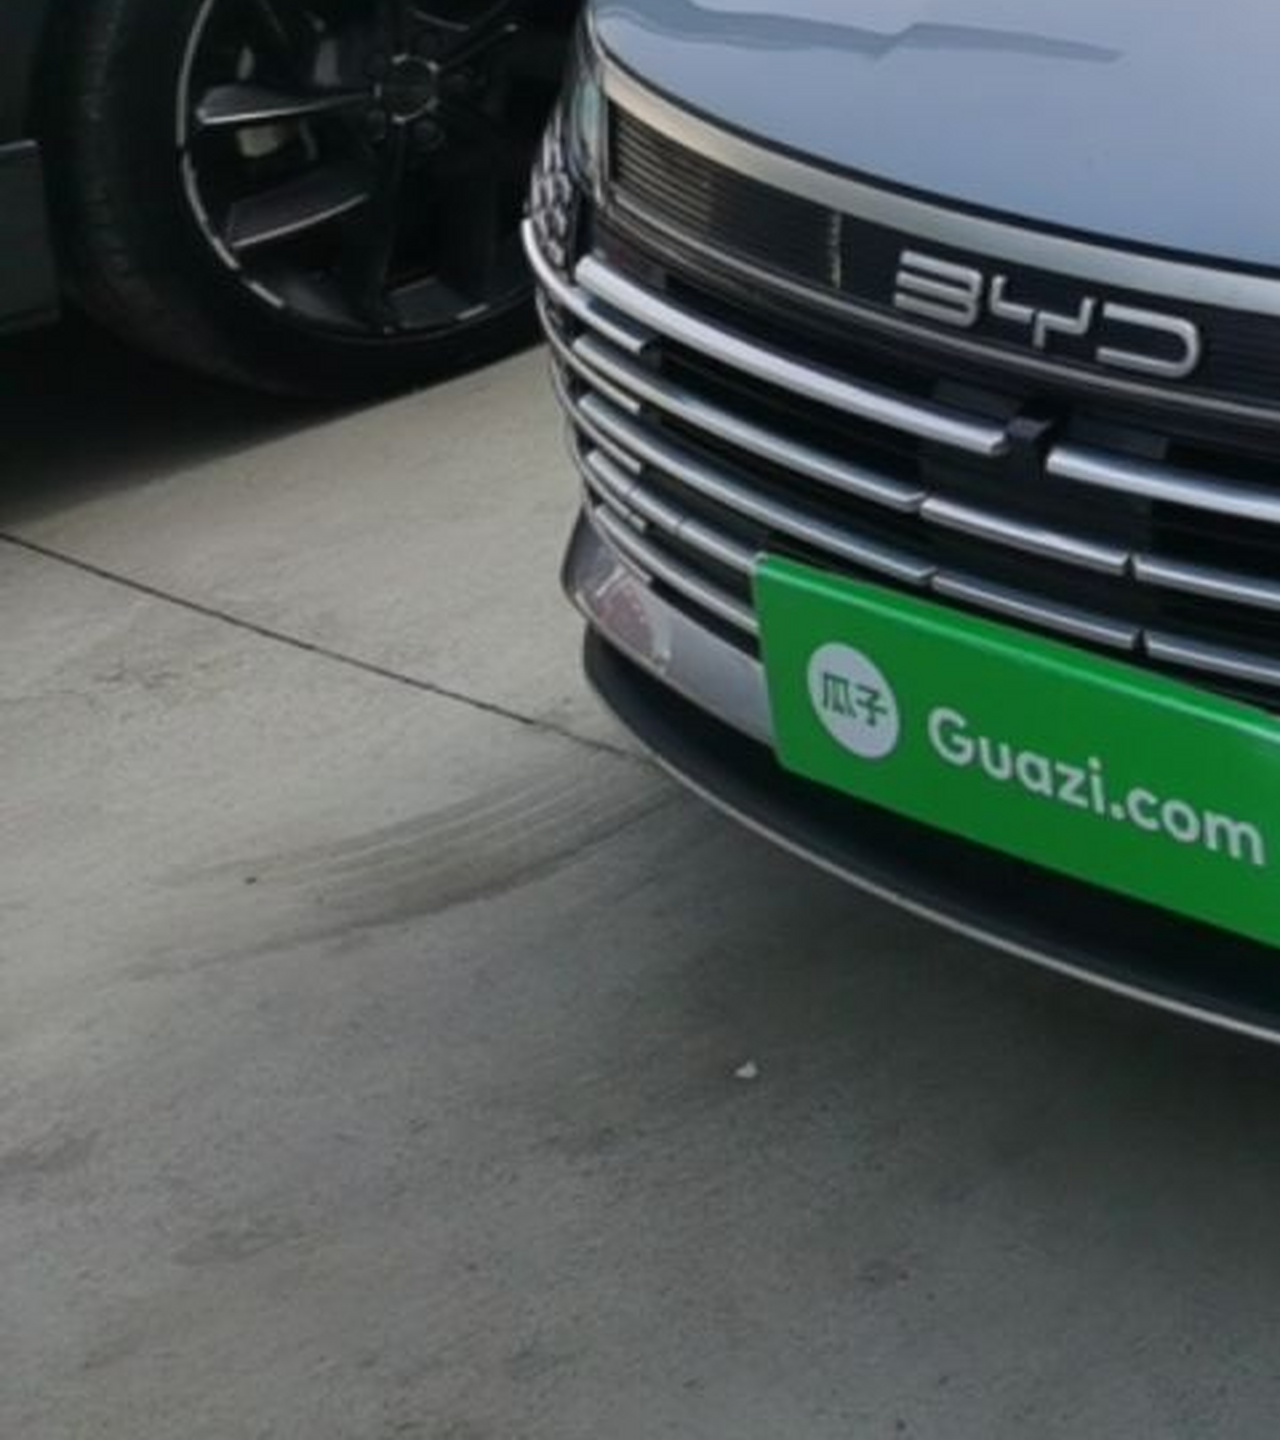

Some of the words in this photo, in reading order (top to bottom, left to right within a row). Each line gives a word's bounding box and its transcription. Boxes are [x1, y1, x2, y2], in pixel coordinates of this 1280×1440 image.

[894, 250, 1198, 379] BYD
[821, 671, 887, 727] 瓜子
[927, 707, 1266, 867] Guazi.com
